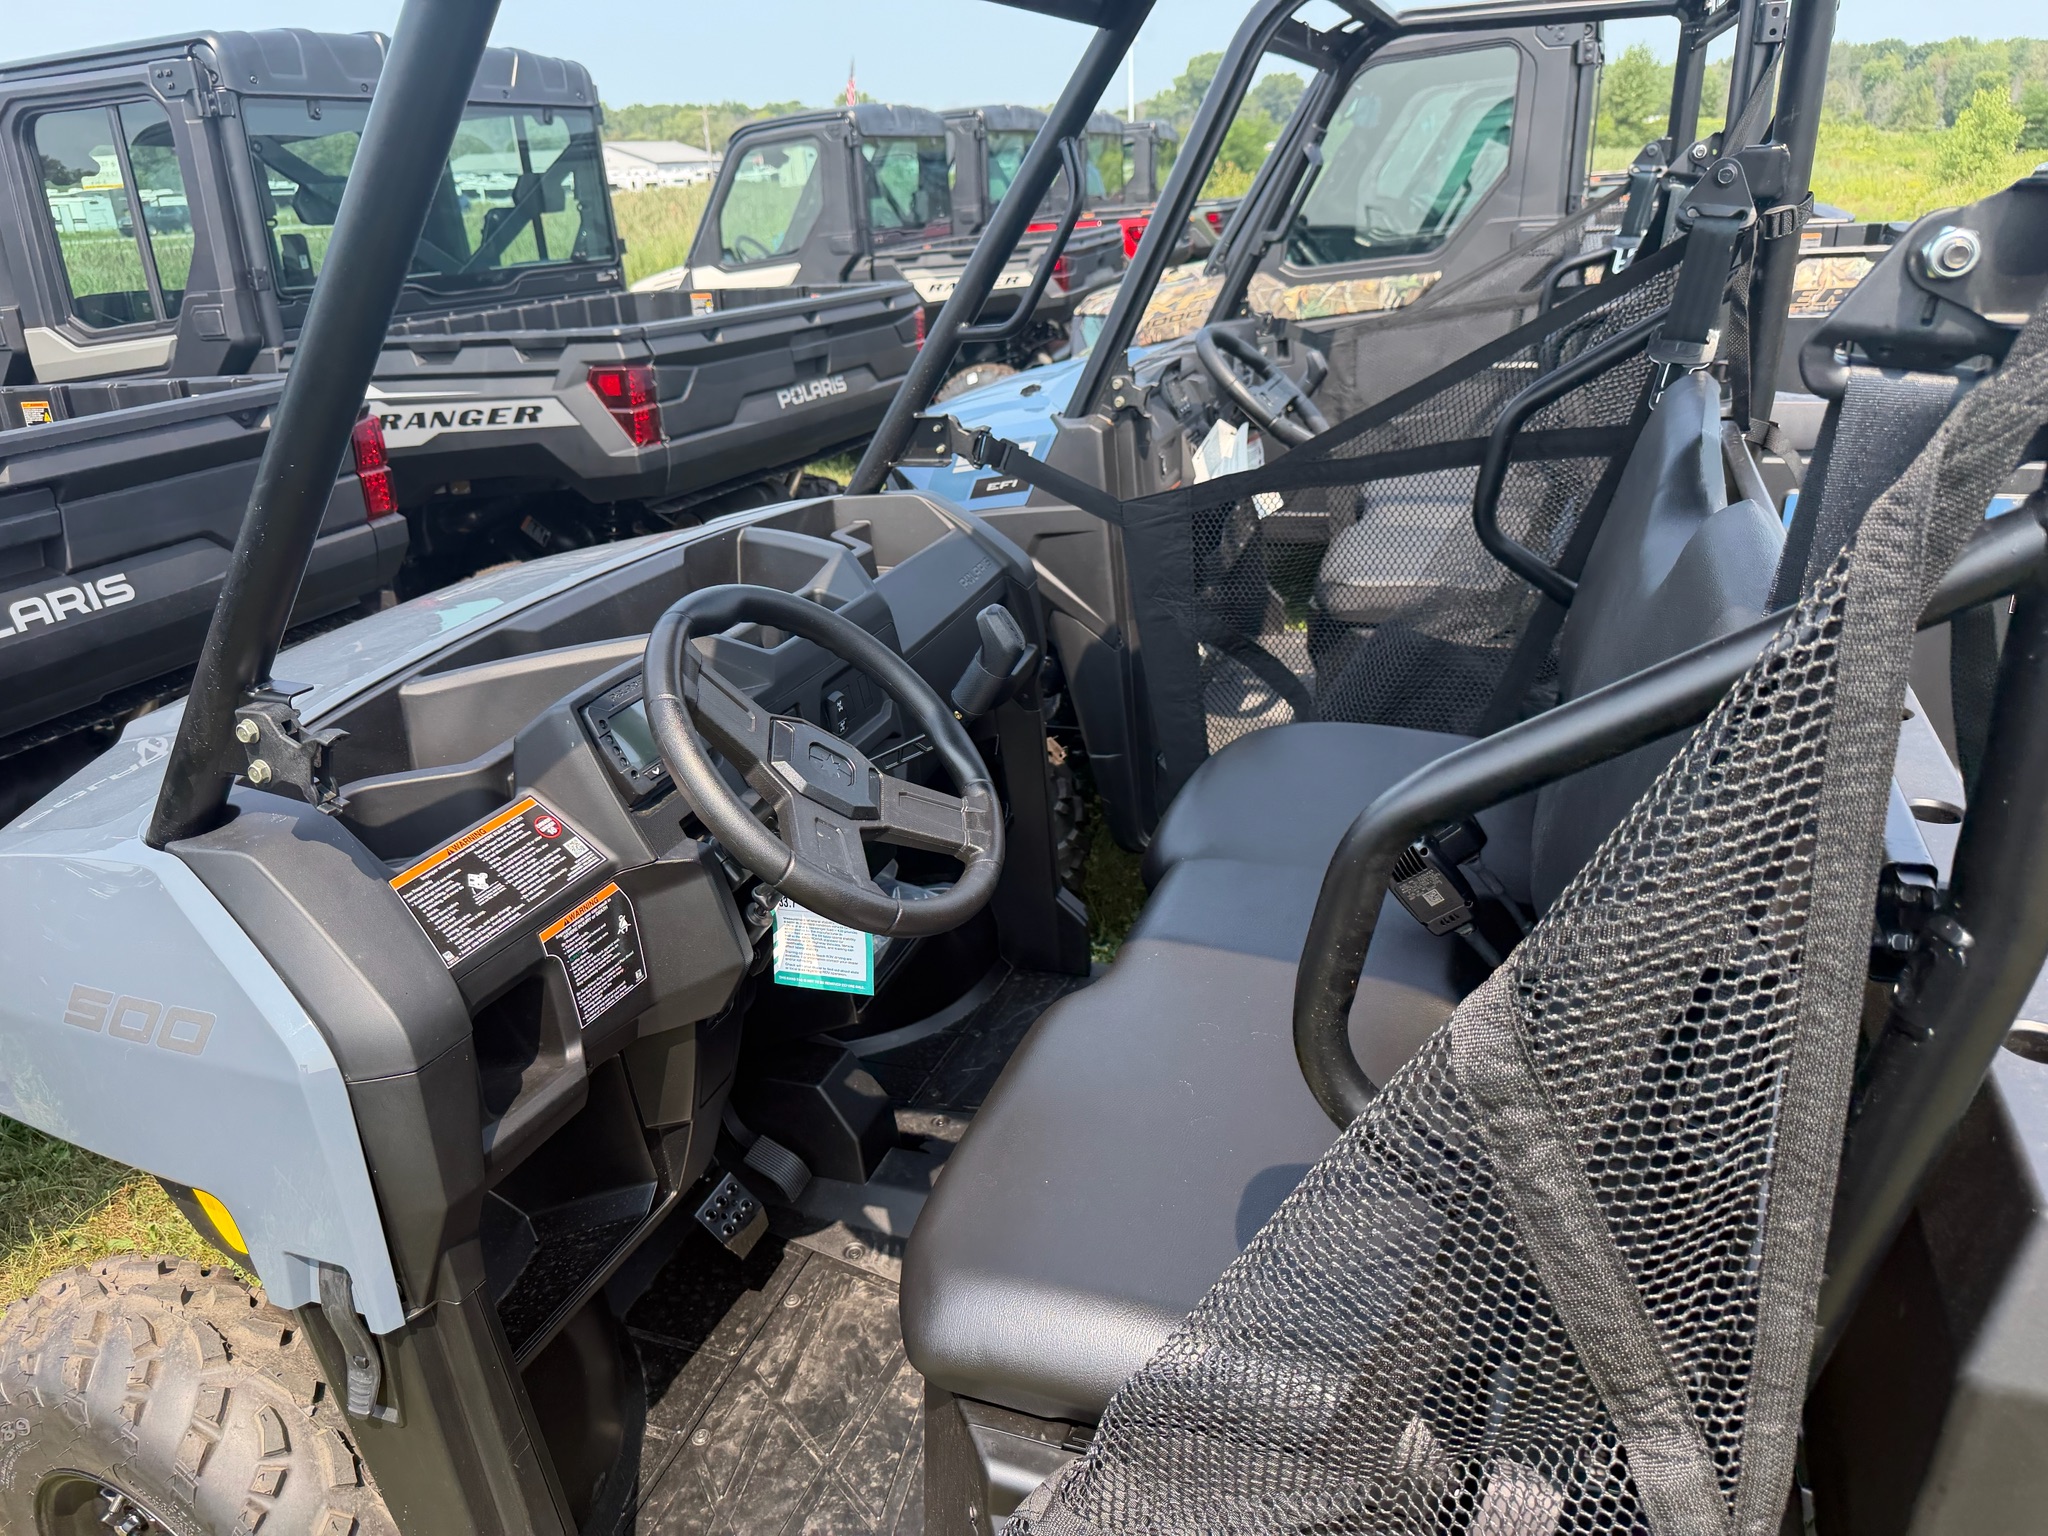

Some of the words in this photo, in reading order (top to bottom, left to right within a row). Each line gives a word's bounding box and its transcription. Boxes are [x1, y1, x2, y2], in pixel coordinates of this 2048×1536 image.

[929, 276, 1019, 293] RAER
[776, 375, 848, 409] POLARIS
[380, 404, 543, 431] RANGER
[986, 479, 1018, 492] EFI
[451, 827, 487, 851] WARNING
[568, 896, 599, 921] WARNING
[63, 982, 217, 1057] 500
